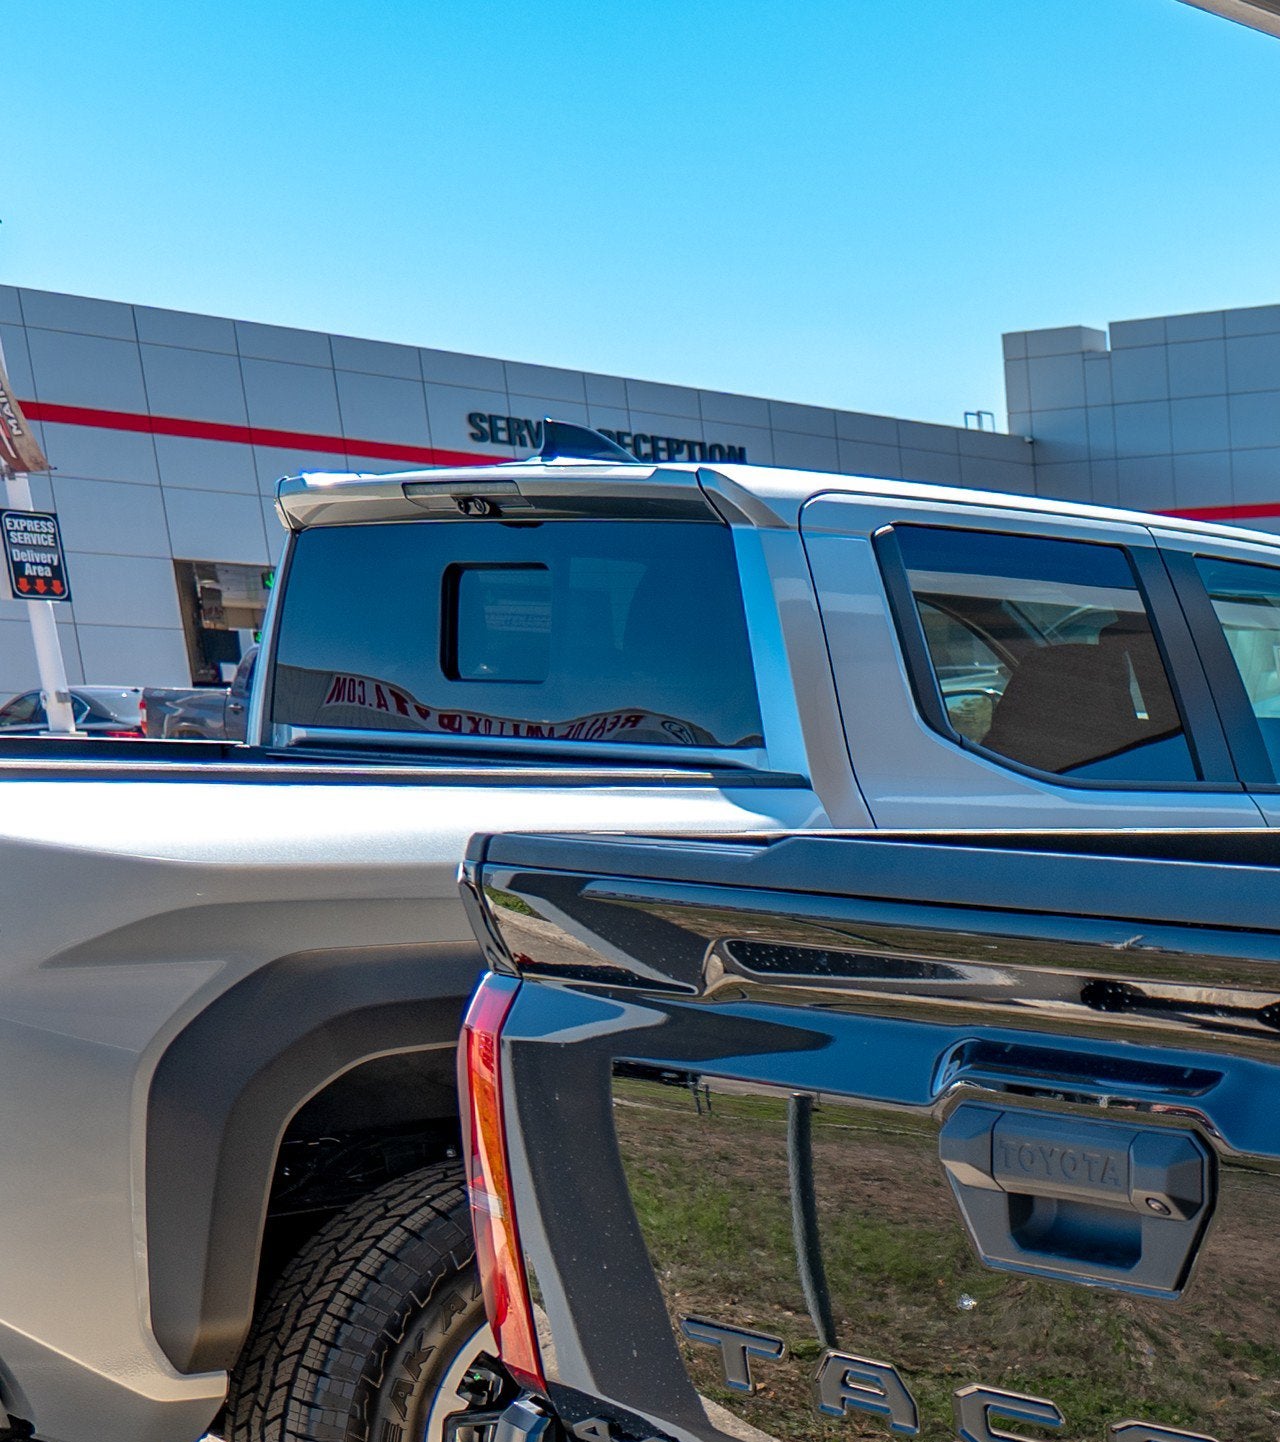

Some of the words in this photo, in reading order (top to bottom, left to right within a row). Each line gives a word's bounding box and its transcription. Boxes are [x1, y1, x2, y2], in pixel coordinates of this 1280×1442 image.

[6, 517, 55, 533] EXPRESS
[10, 532, 55, 546] SERVICE
[12, 549, 59, 566] Delivery
[24, 562, 52, 577] Area
[1001, 1141, 1122, 1187] TOYOTA
